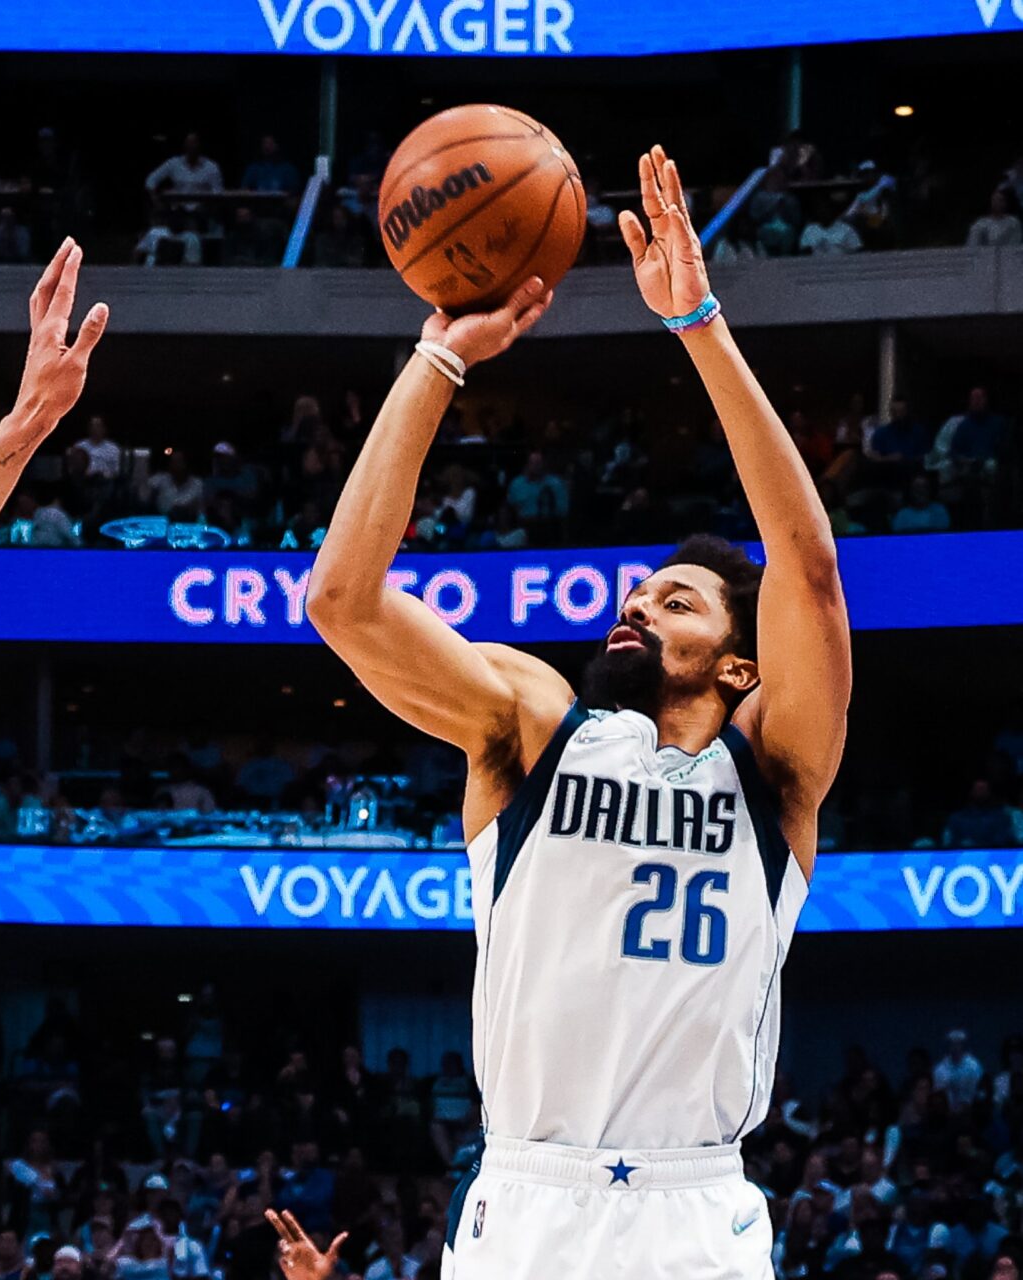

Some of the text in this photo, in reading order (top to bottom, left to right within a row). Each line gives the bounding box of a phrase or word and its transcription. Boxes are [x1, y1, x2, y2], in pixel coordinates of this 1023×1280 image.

[258, 0, 574, 52] VOYAGER
[383, 161, 494, 250] Wilson
[168, 566, 478, 627] CRYO
[548, 772, 737, 857] DALLAS
[239, 864, 473, 919] VOYAGE
[621, 862, 730, 966] 26
[902, 864, 1023, 918] VOY
